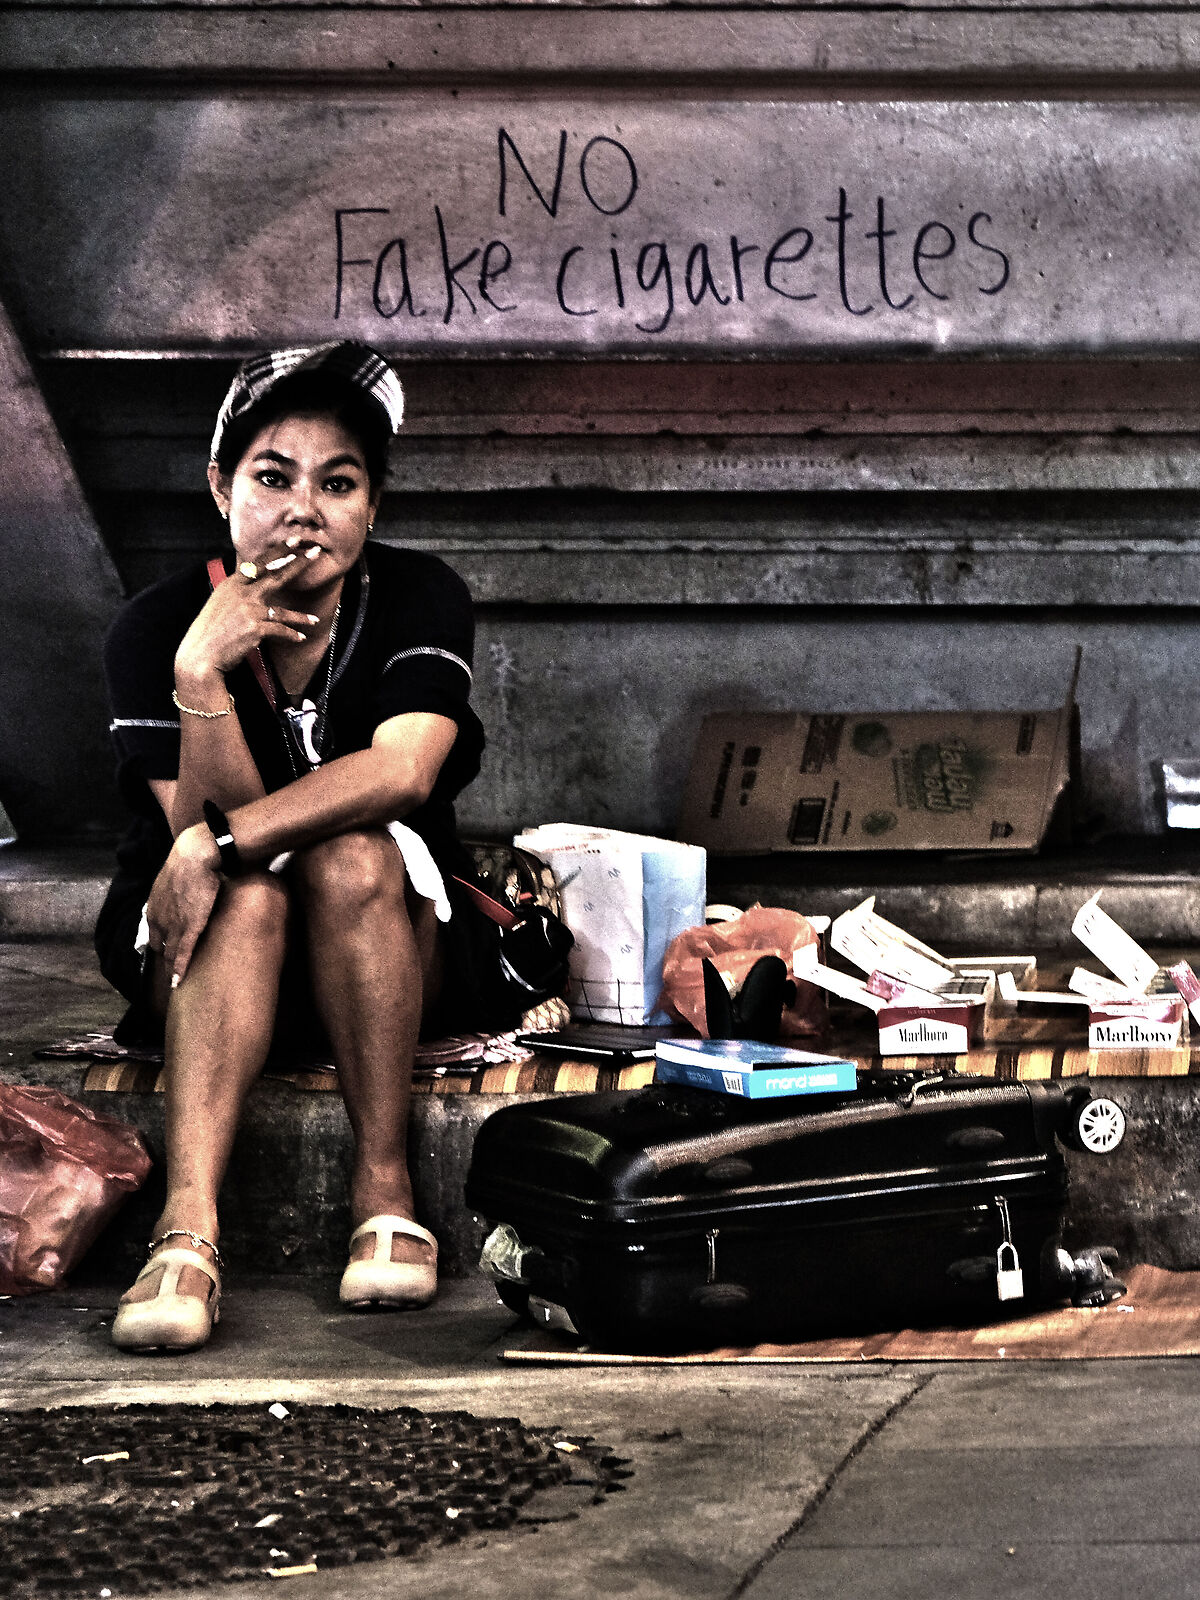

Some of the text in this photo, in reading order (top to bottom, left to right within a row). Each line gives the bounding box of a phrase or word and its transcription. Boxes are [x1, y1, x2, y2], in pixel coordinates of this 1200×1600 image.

[498, 127, 639, 218] NO
[334, 188, 1011, 334] Fake cigarettes
[898, 1022, 949, 1043] Marlboro
[1096, 1025, 1173, 1042] Marlboro
